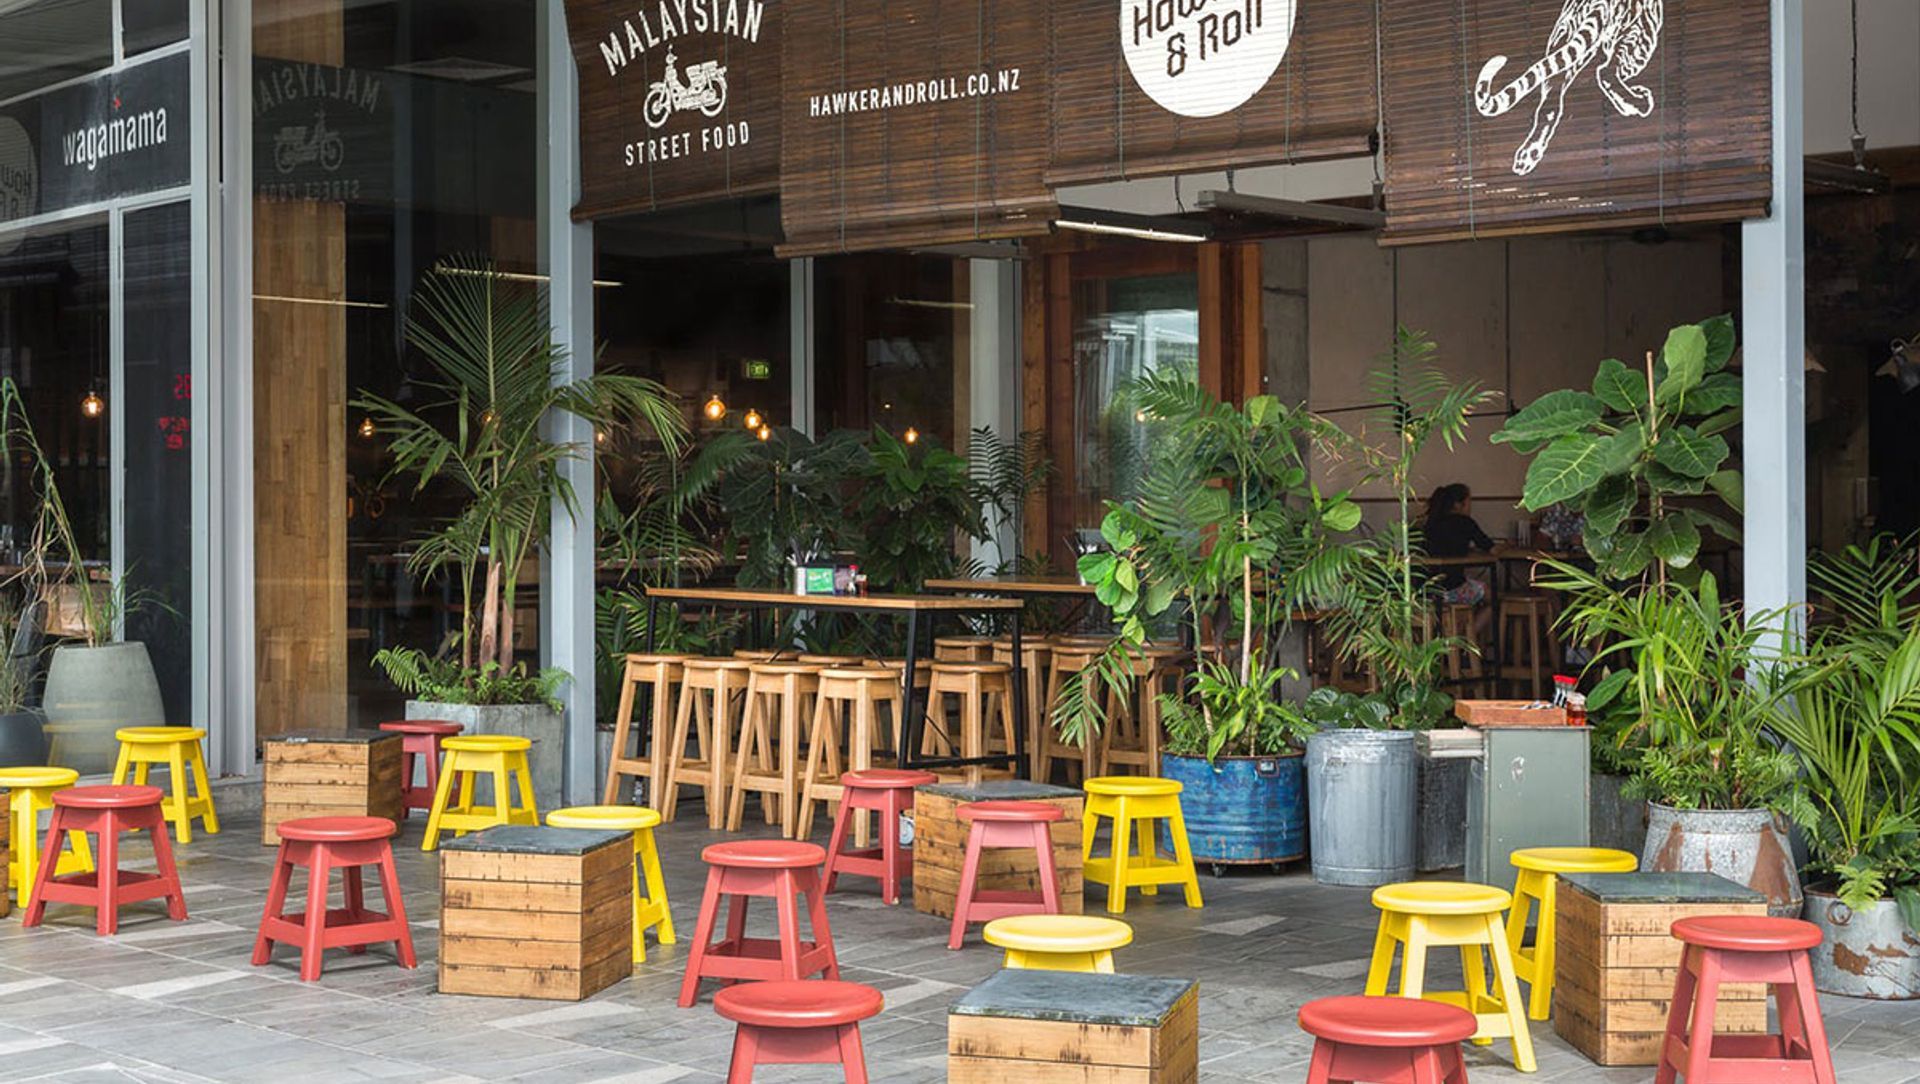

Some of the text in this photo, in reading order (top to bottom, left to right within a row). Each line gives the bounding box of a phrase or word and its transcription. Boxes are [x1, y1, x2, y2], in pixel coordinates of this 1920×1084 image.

[600, 0, 764, 76] MALAYSIAN
[1166, 0, 1262, 78] & Roll
[810, 68, 1020, 117] HAWKERANDROLL.CO.NZ
[62, 107, 167, 171] wagamama
[625, 121, 749, 166] STREET FOOD
